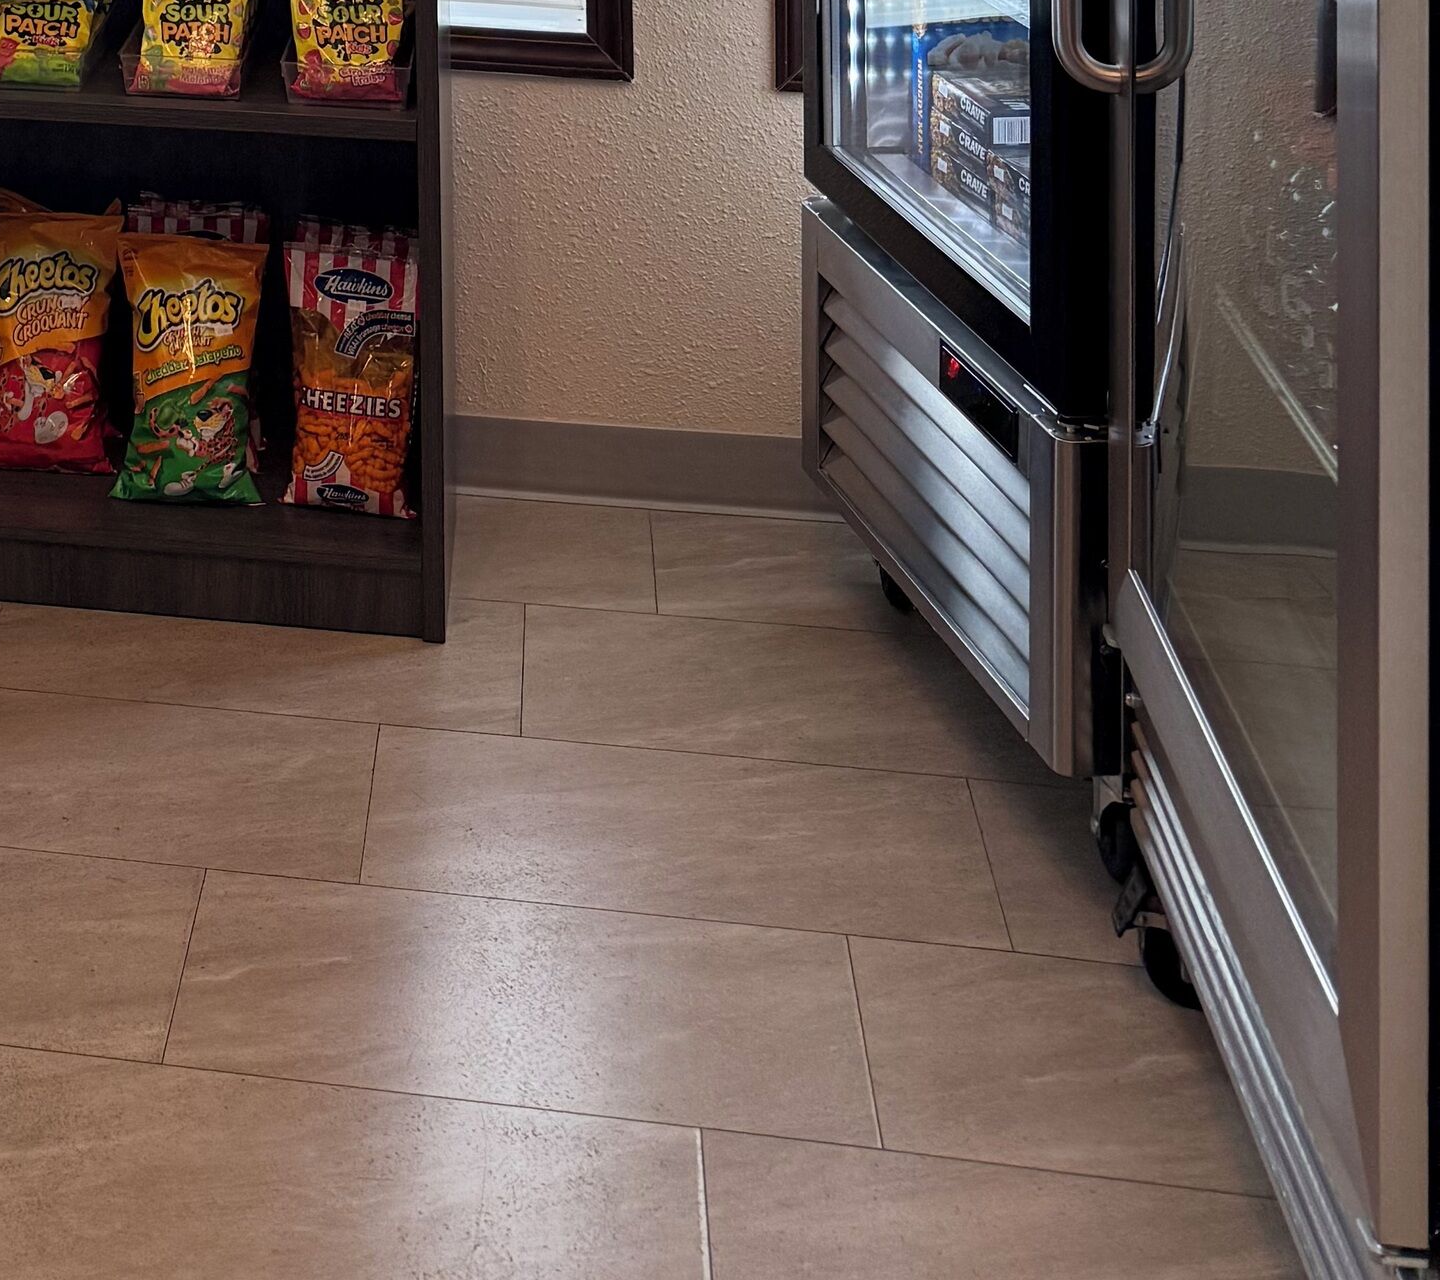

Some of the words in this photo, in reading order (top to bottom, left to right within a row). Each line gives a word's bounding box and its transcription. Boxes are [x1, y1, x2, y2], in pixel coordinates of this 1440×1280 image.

[9, 1, 78, 23] SOUR
[165, 3, 229, 24] SOUR
[317, 3, 383, 25] SOUR
[5, 14, 77, 38] PATCH
[162, 23, 230, 43] PATCH
[315, 23, 386, 45] PATCH
[960, 95, 986, 126] CRAVE
[958, 130, 986, 162] CRAVE
[960, 169, 988, 200] CRAVE
[323, 274, 389, 297] Hawkins
[137, 280, 243, 348] Cheetos
[13, 311, 89, 346] CROQUANT
[301, 386, 401, 419] HEEZIES
[322, 486, 368, 501] Hawkins
